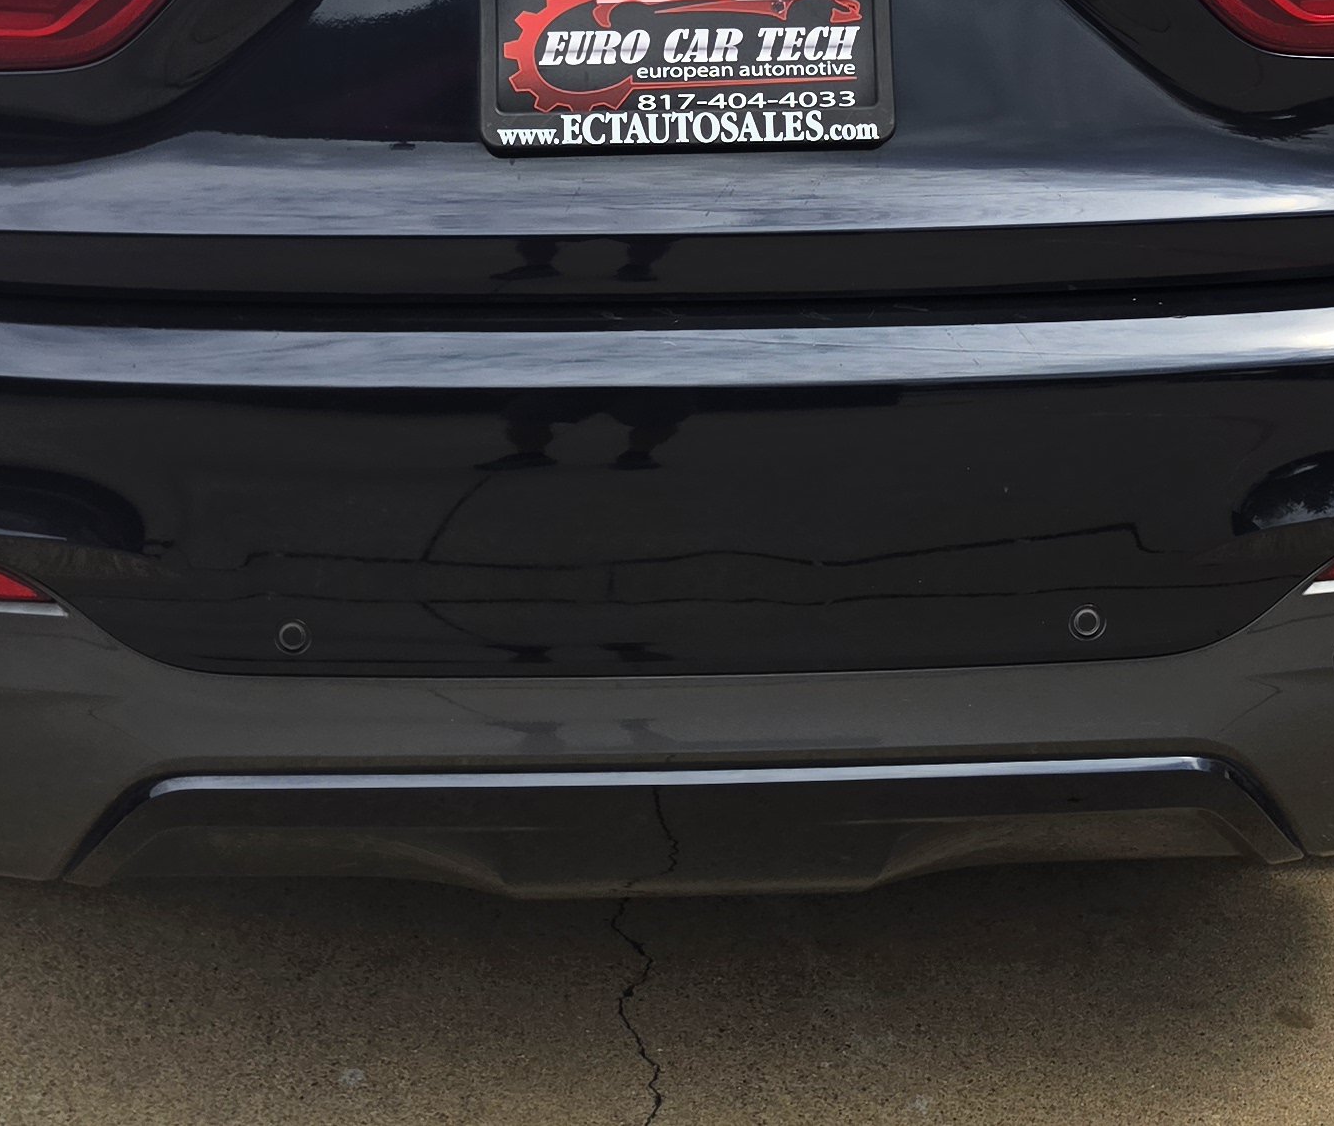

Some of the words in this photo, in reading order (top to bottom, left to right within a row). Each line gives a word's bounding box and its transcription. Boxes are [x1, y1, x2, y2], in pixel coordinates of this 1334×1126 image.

[539, 30, 651, 66] EURO
[663, 28, 744, 63] CAR
[757, 26, 861, 62] TECH
[635, 65, 734, 80] european
[739, 60, 856, 78] automotive
[637, 91, 856, 112] 817-404-4033
[497, 111, 880, 146] www.ECTAUTOSALES.com
